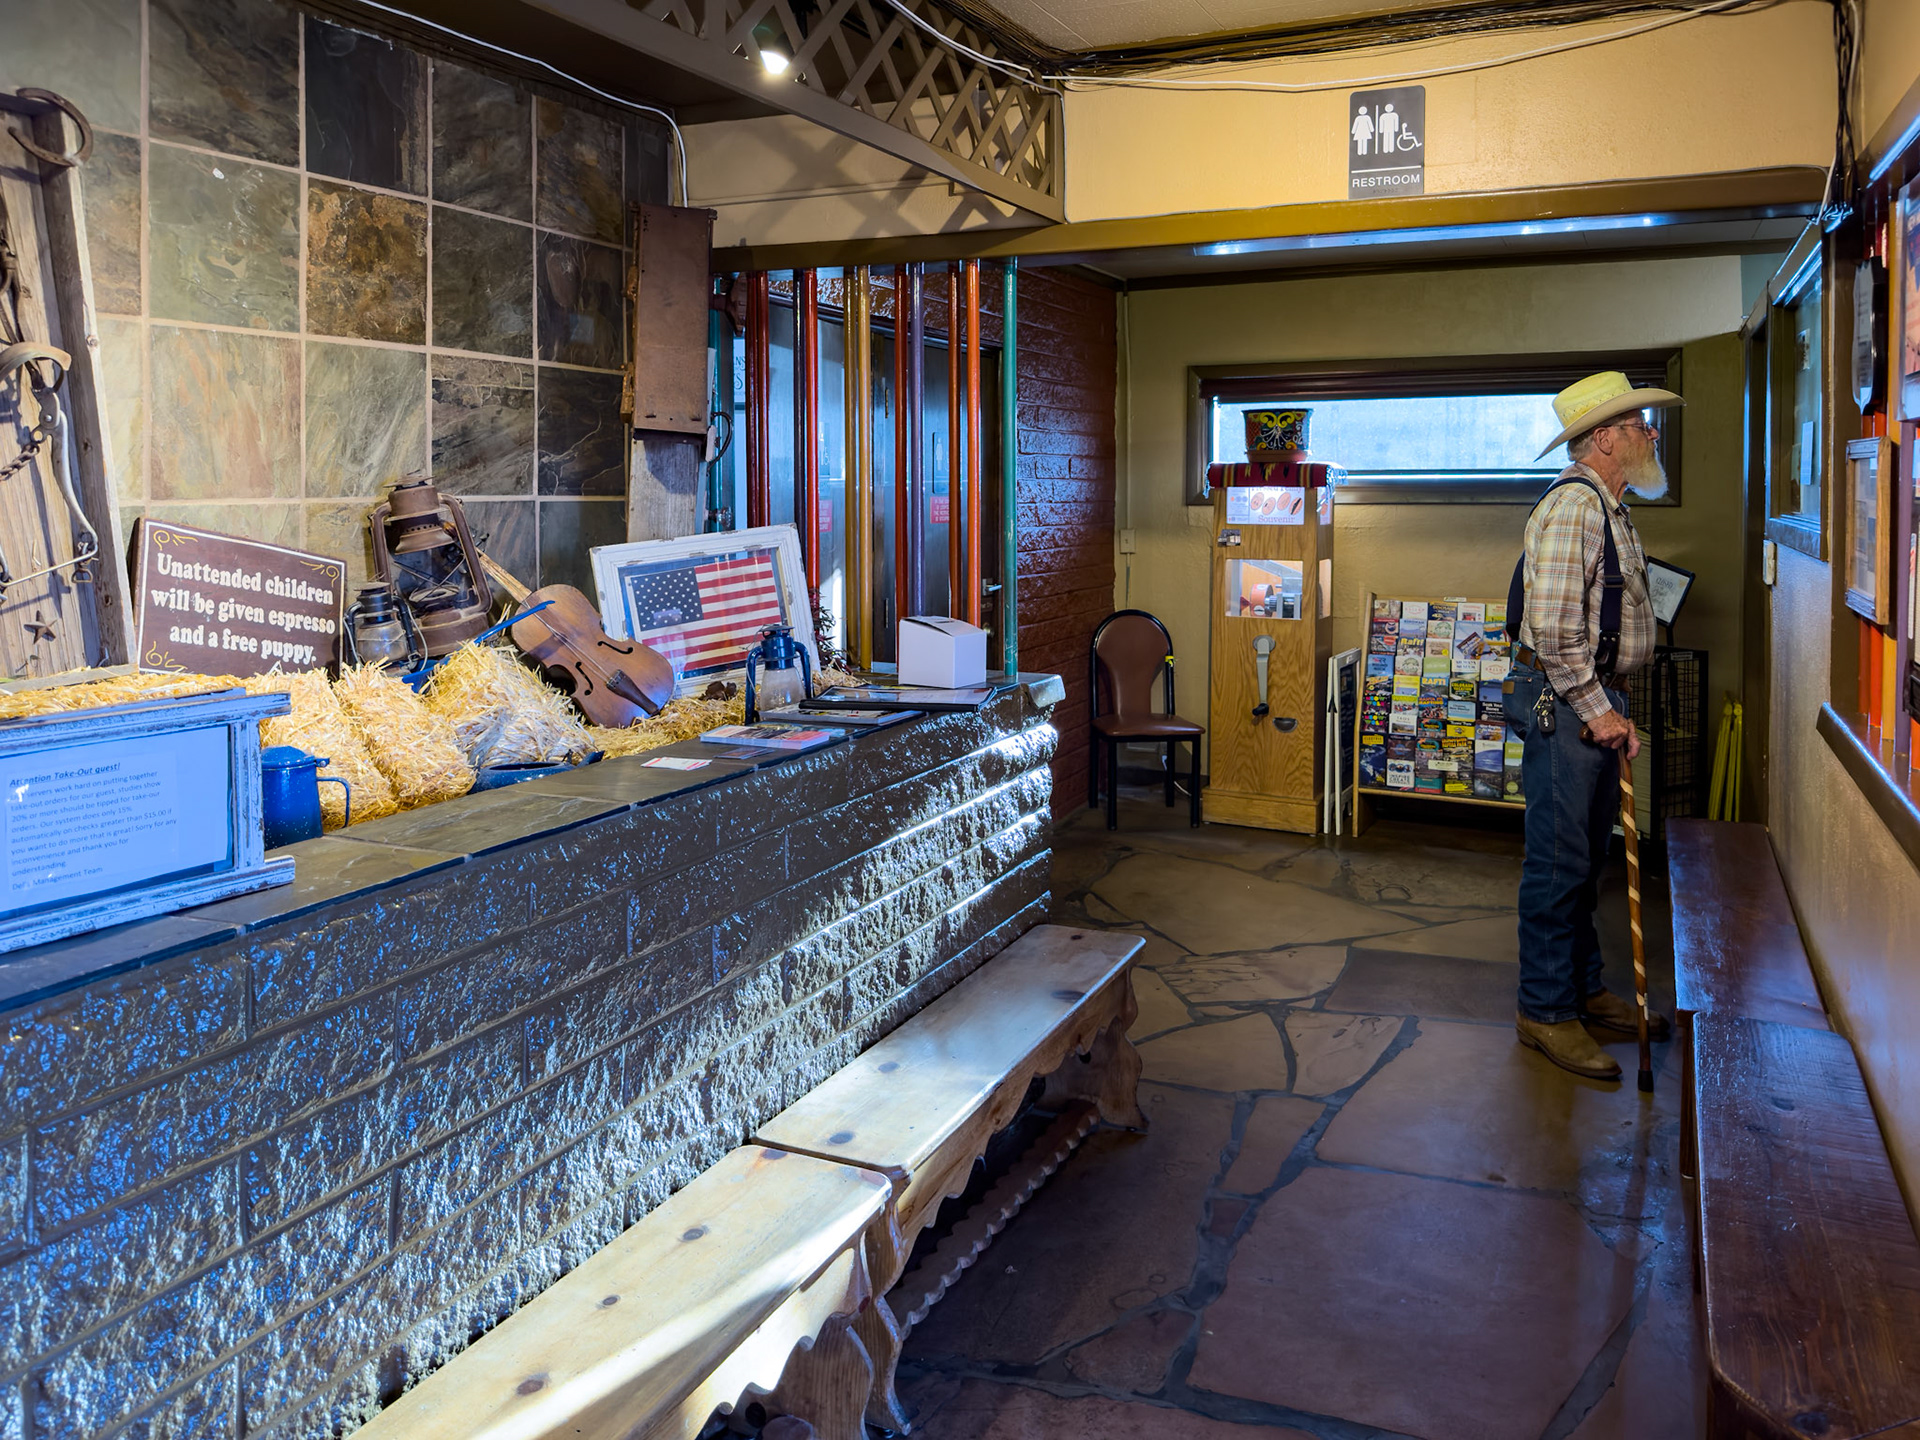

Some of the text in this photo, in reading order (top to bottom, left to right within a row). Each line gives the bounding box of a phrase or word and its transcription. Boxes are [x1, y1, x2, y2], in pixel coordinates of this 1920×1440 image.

[1352, 174, 1420, 188] RESTROOM
[1258, 515, 1295, 523] Souvenir
[157, 553, 334, 605] Unattended children
[151, 588, 336, 635] will be given espresso
[169, 624, 317, 666] and a free puppy.
[54, 767, 93, 780] Take-Out
[54, 784, 72, 793] work
[74, 780, 91, 790] hard
[103, 776, 128, 786] putting
[129, 771, 158, 781] together
[39, 808, 59, 817] more
[60, 803, 85, 813] should
[86, 801, 96, 809] be
[96, 798, 119, 808] tipped
[132, 791, 160, 801] take-out
[44, 796, 68, 806] orders
[69, 794, 80, 802] for
[81, 792, 94, 800] our
[118, 784, 142, 793] studies
[11, 829, 62, 844] automatically
[73, 823, 99, 832] checks
[100, 818, 125, 828] greater
[127, 814, 143, 822] than
[40, 820, 54, 828] Our
[55, 816, 81, 826] system
[82, 812, 100, 820] does
[101, 808, 116, 817] only
[11, 848, 26, 856] you
[27, 843, 47, 852] want
[58, 838, 68, 846] do
[70, 835, 89, 844] more
[90, 831, 105, 840] that
[135, 822, 153, 832] Sorry
[67, 846, 81, 855] and
[82, 842, 103, 852] thank
[11, 860, 67, 877] understanding
[83, 866, 103, 875] Team
